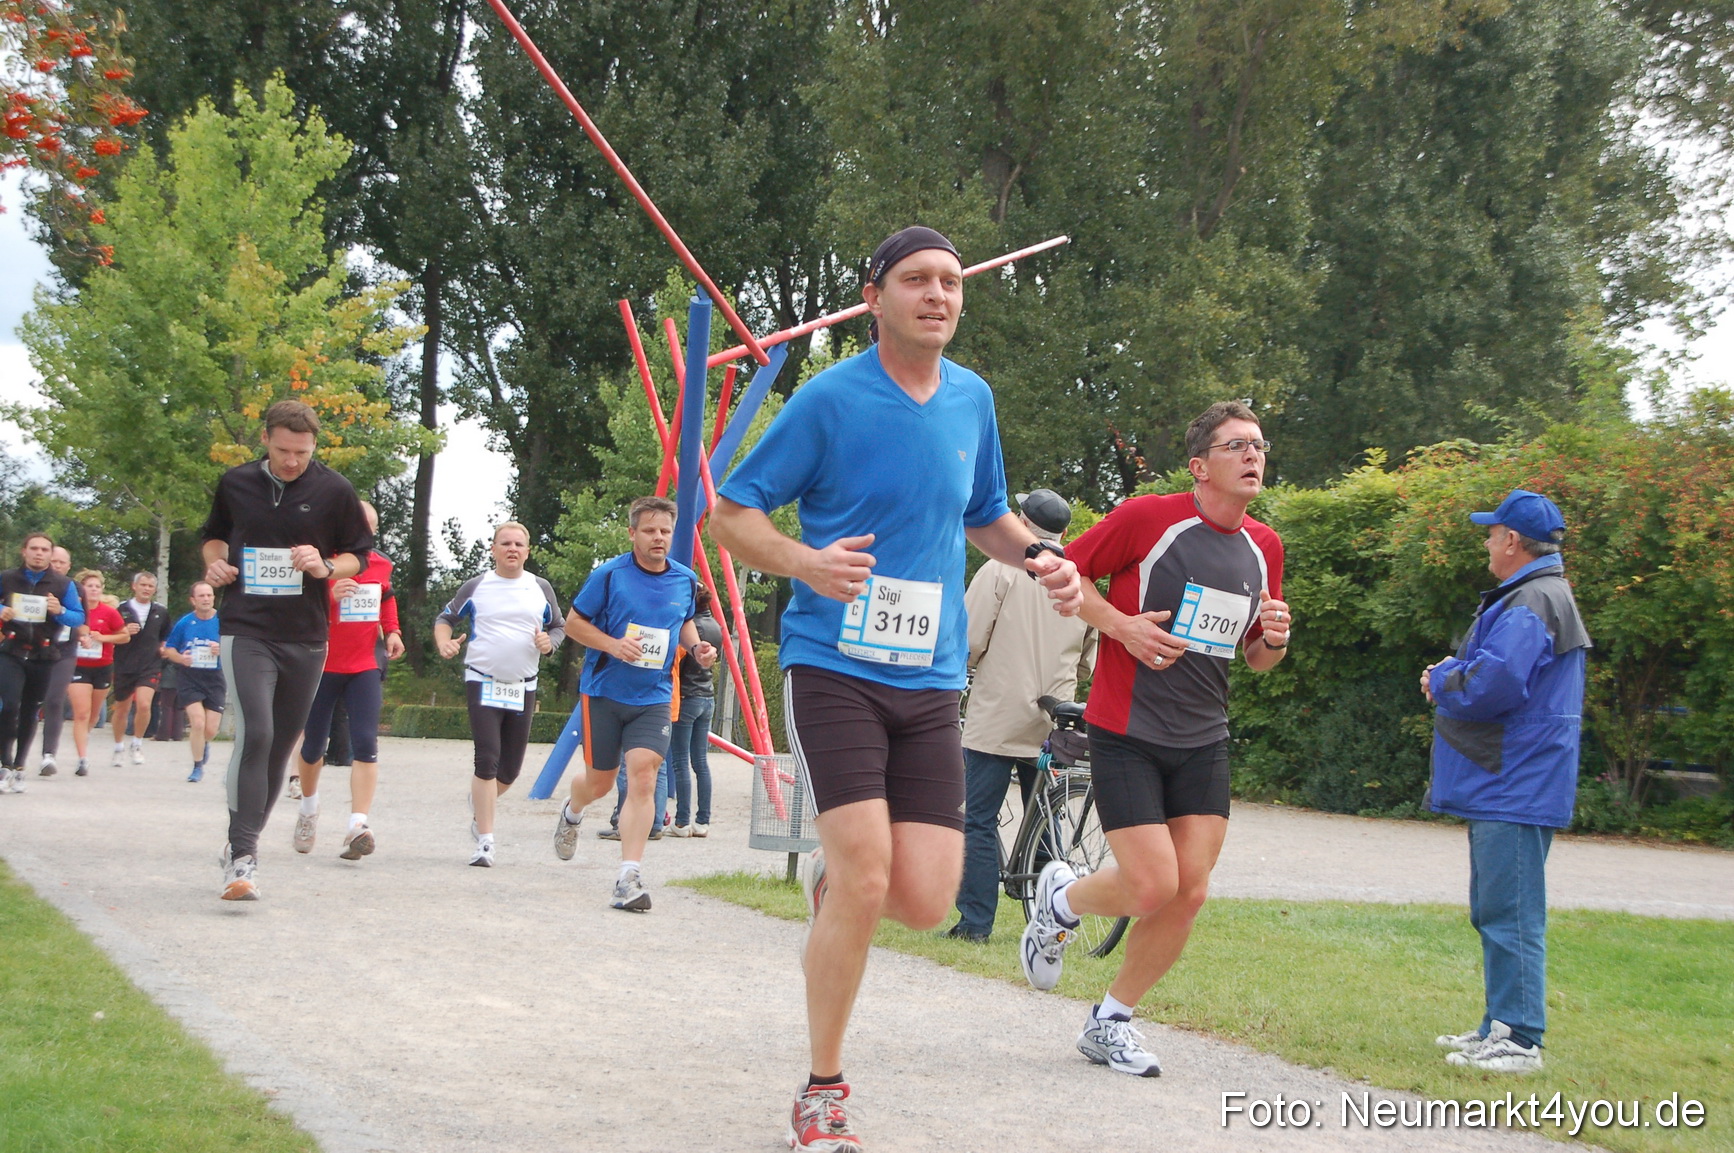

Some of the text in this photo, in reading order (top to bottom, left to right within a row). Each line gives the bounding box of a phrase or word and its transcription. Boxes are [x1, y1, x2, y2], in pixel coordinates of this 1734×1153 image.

[260, 552, 283, 561] Stefan
[260, 566, 295, 578] 2957
[878, 585, 902, 606] Sigi
[354, 598, 378, 609] 3350
[24, 606, 40, 614] 908
[851, 604, 859, 616] C
[874, 610, 930, 636] 3119
[1198, 613, 1239, 636] 3701
[639, 630, 656, 640] Hans-
[495, 686, 520, 699] 3198
